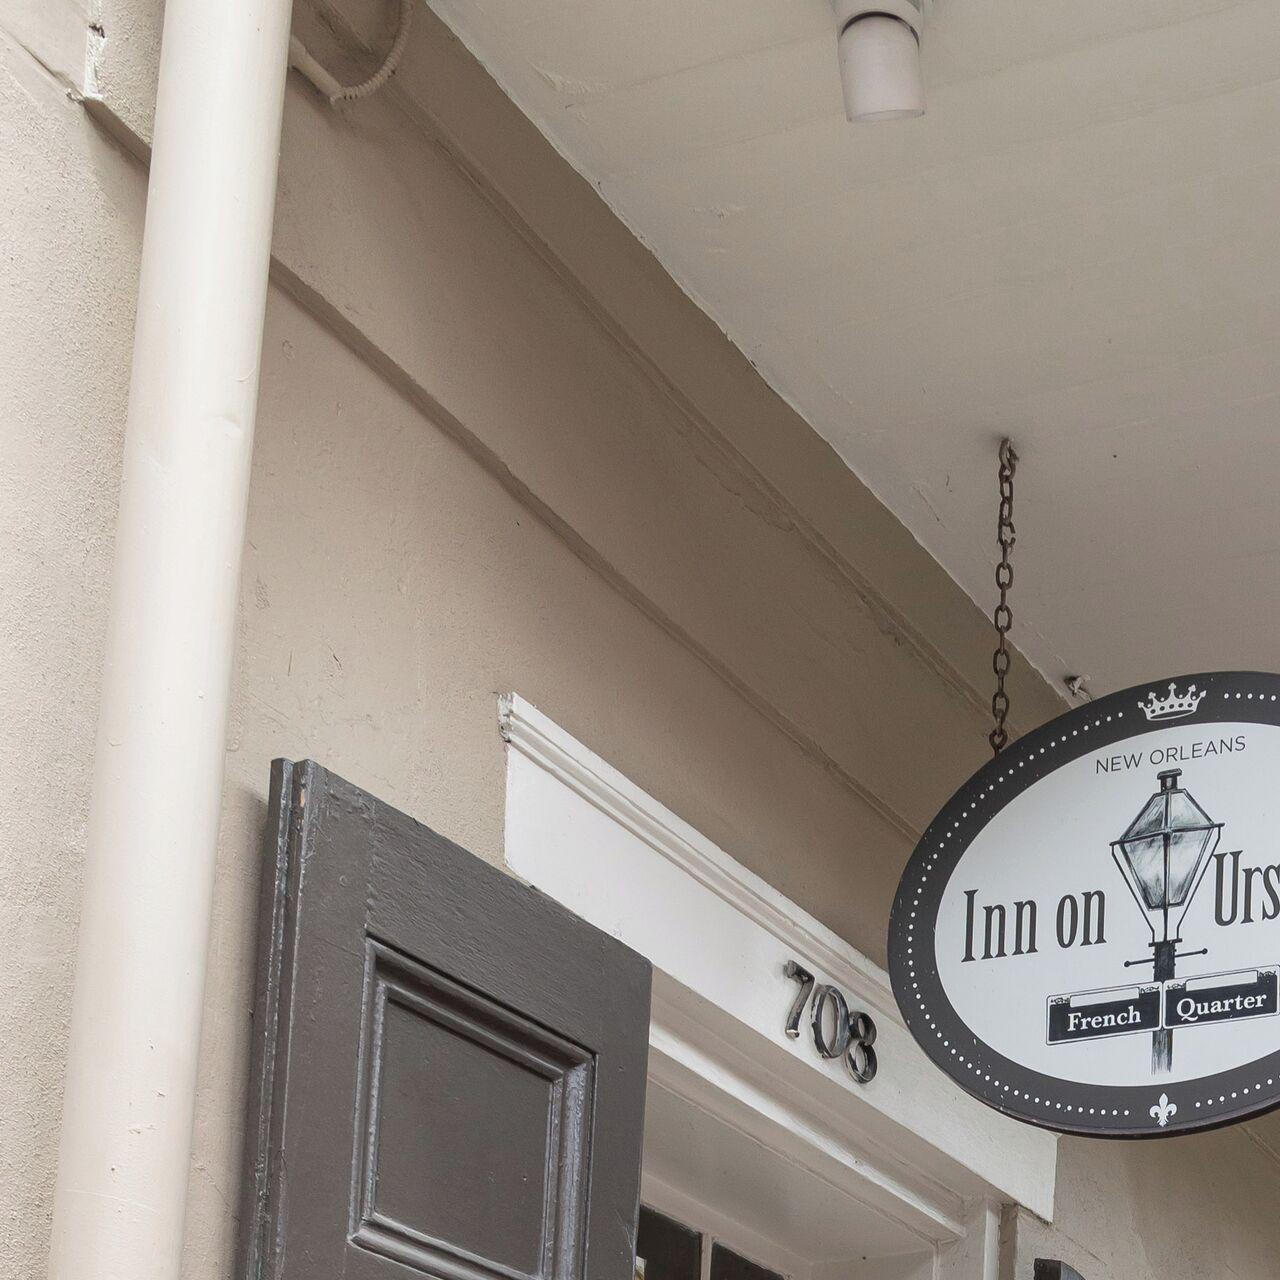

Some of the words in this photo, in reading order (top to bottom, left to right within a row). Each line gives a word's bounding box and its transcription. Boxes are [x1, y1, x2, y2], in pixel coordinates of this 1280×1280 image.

[1095, 752, 1143, 774] NEW
[1149, 735, 1246, 765] ORLEANS
[961, 889, 1038, 963] Inn
[1055, 890, 1107, 949] on
[783, 959, 878, 1084] 708
[1066, 1005, 1142, 1032] French
[1176, 993, 1267, 1022] Quarter
